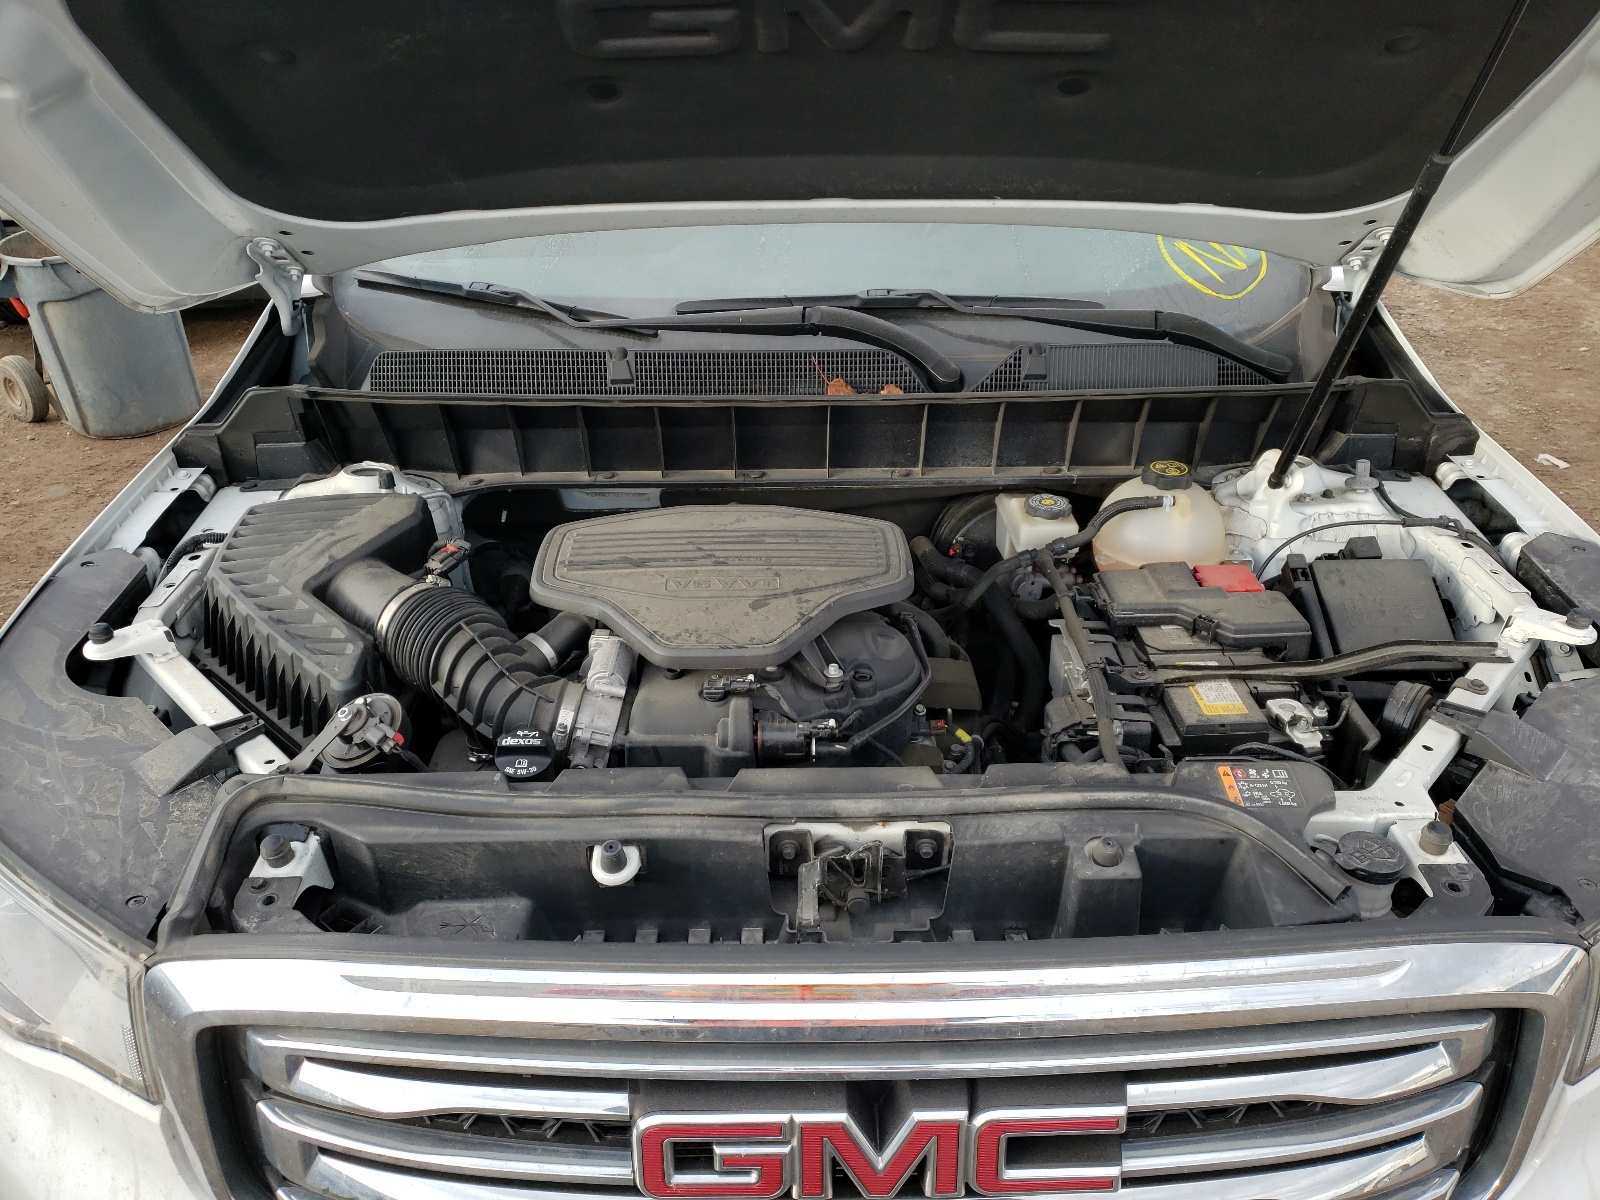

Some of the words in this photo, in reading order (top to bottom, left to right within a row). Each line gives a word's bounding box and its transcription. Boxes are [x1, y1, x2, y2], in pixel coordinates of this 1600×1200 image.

[558, 0, 1112, 59] GMC
[669, 579, 711, 590] V6
[502, 737, 542, 746] dexos
[504, 766, 515, 774] SAE
[517, 766, 537, 775] 5W-30
[634, 1106, 1127, 1198] GMC
